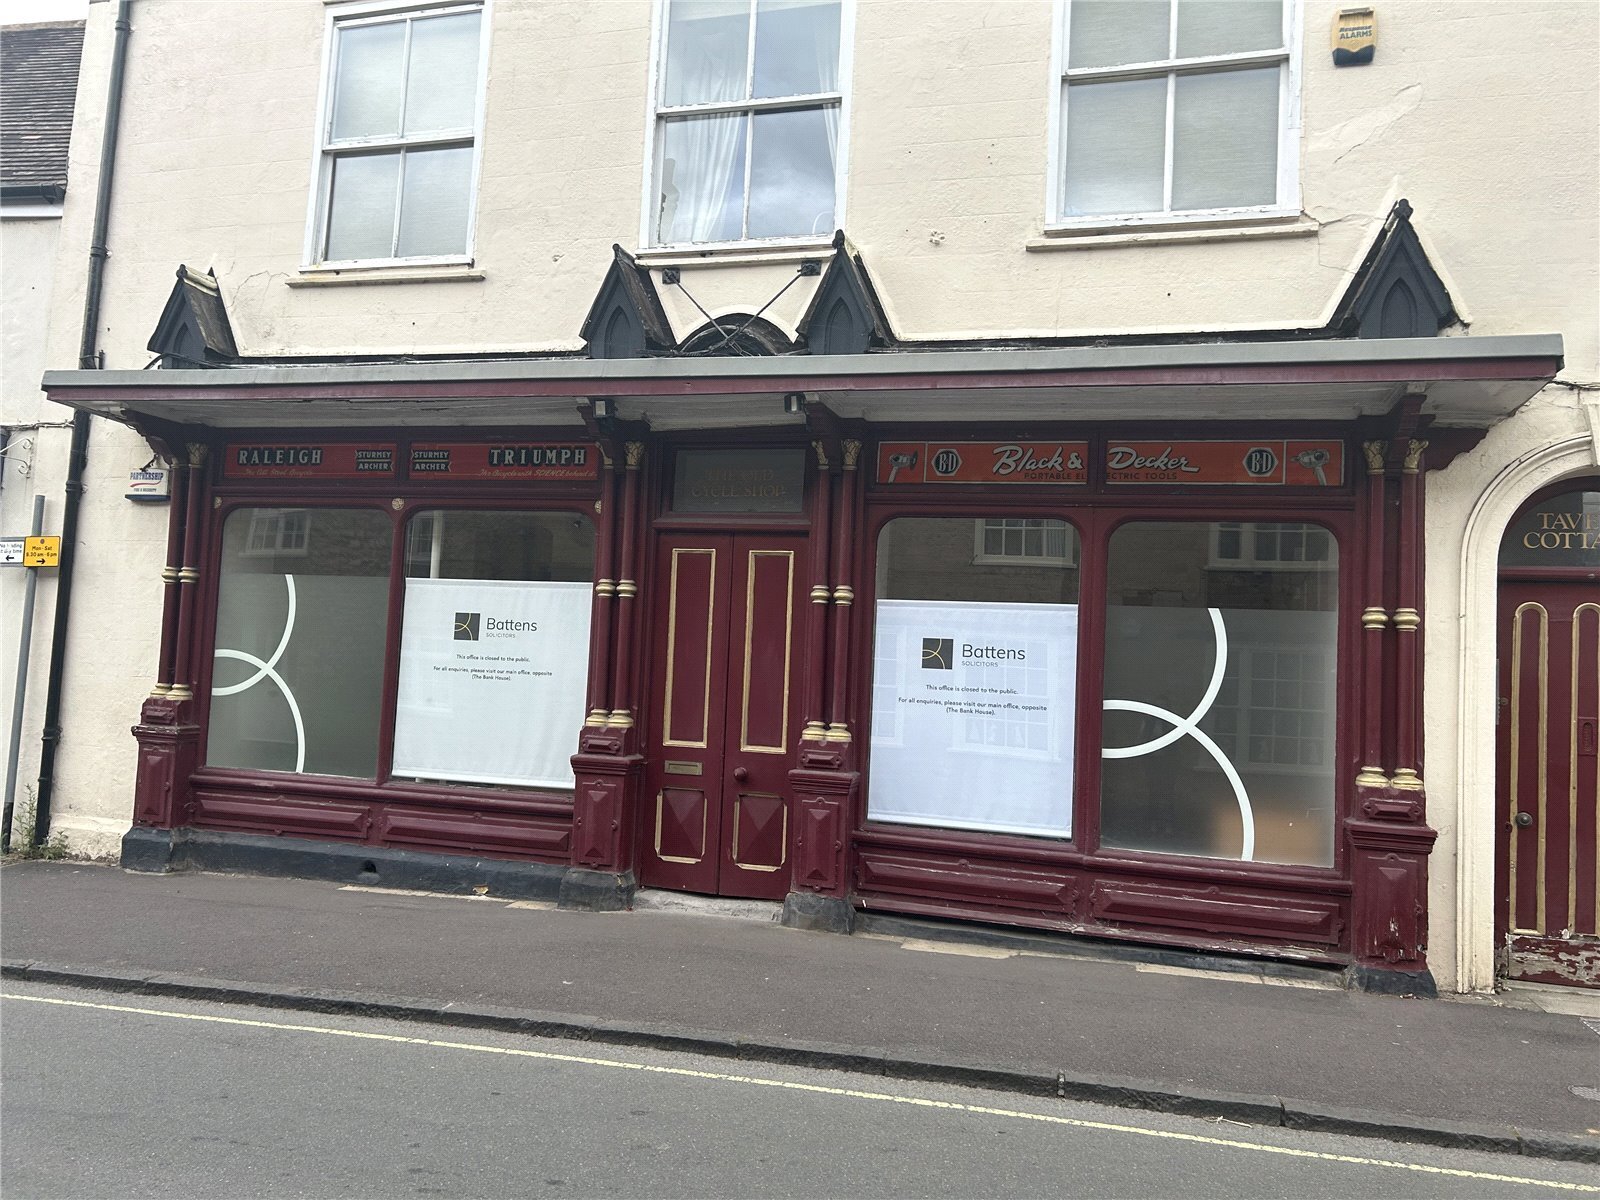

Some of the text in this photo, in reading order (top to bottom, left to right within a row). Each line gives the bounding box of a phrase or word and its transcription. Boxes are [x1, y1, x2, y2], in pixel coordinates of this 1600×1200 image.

[1339, 30, 1372, 39] ALARMS
[239, 449, 322, 465] RALEIGH
[358, 451, 391, 459] STURMEY
[414, 451, 449, 459] STURMEY
[490, 449, 585, 465] TRIUMPH
[993, 444, 1200, 475] Black & Decker
[1024, 472, 1072, 480] PORTABLE
[1145, 472, 1177, 480] TOOLS
[744, 484, 784, 497] SHOP
[486, 617, 538, 631] Battens
[962, 643, 1026, 660] Battens
